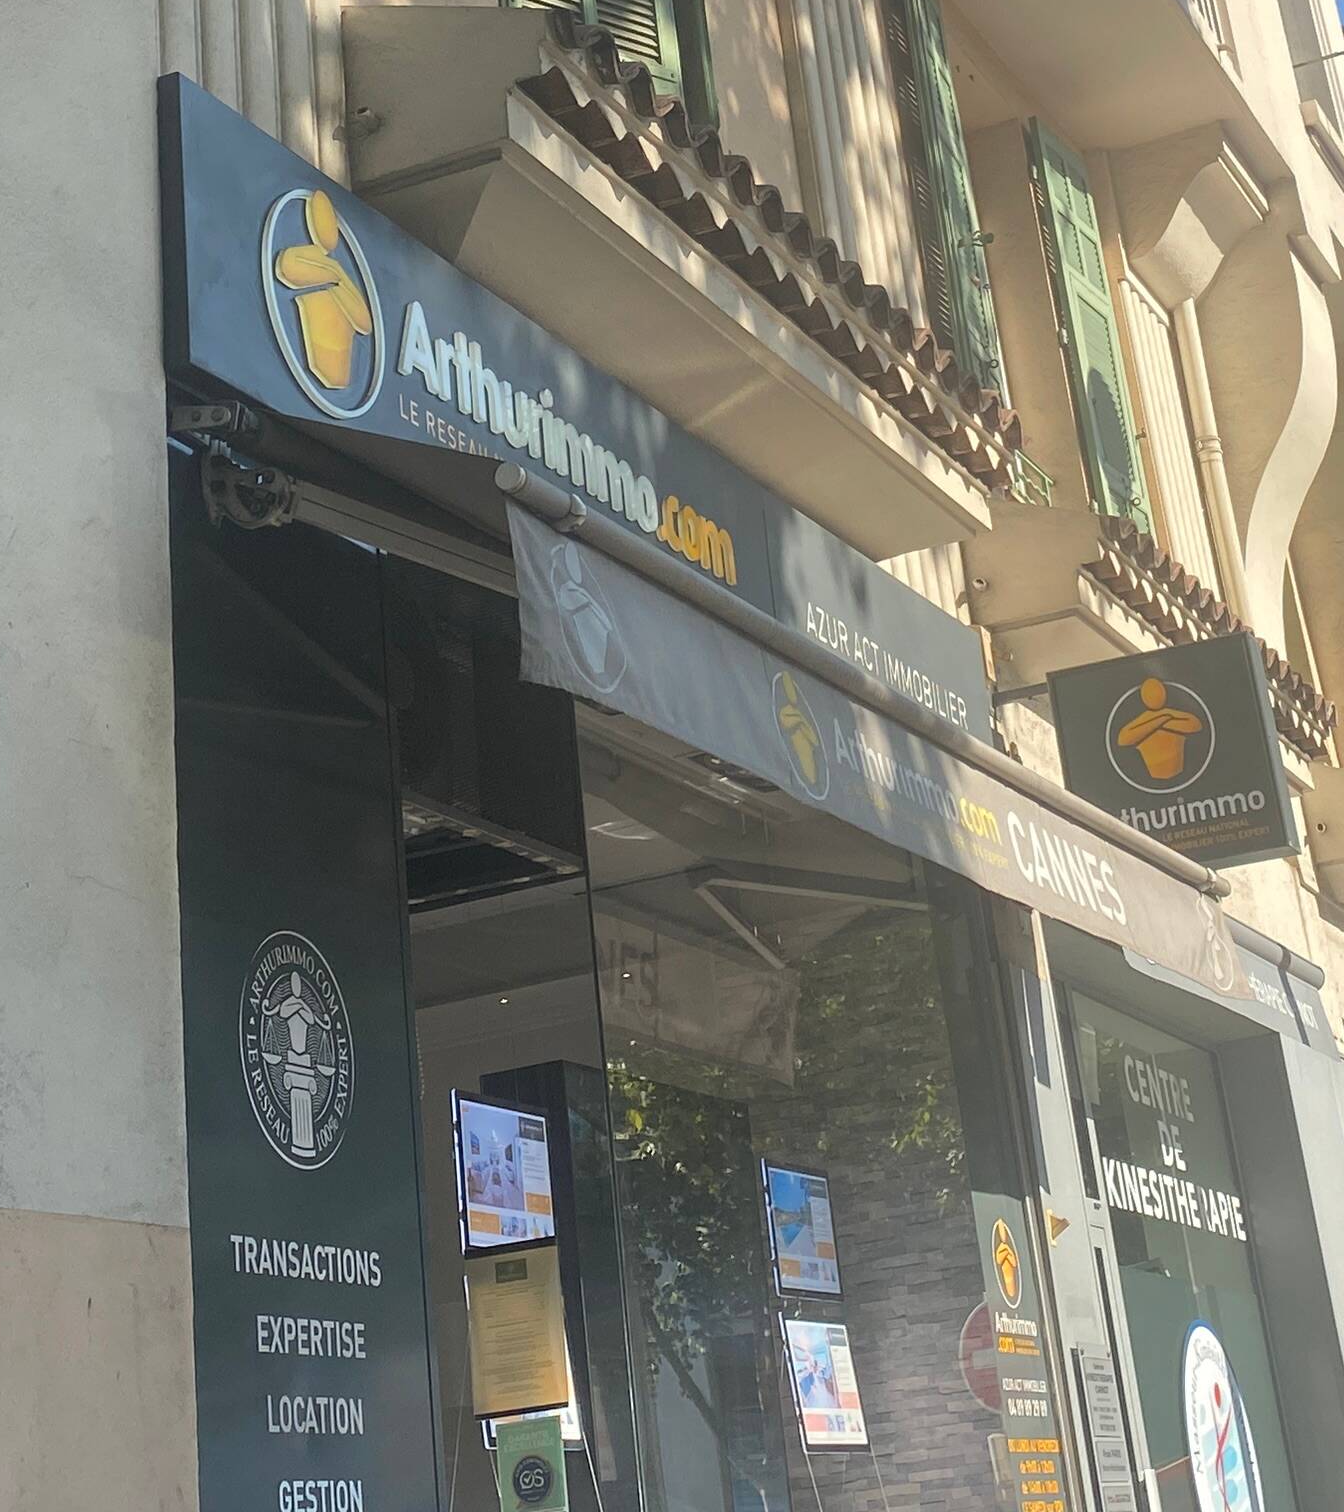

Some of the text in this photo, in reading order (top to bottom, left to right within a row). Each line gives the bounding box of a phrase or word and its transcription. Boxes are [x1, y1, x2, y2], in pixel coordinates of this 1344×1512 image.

[399, 392, 420, 427] LE
[397, 300, 737, 586] Arthurimmo.com
[806, 601, 969, 731] AZUR ACT IMMOBILIER
[833, 718, 1127, 926] Arthurimmo.com CANNES
[1119, 790, 1265, 831] thurimmo
[246, 1033, 350, 1153] LE RESEAU 100% EXPERT
[1123, 1054, 1195, 1123] CENTRE
[1156, 1119, 1187, 1172] DE
[1101, 1156, 1248, 1242] KINESITHERAPIE
[229, 1234, 382, 1287] TRANSACTIONS
[256, 1314, 367, 1359] EXPERTISE
[266, 1394, 365, 1435] LOCATION
[278, 1480, 365, 1512] GESTION
